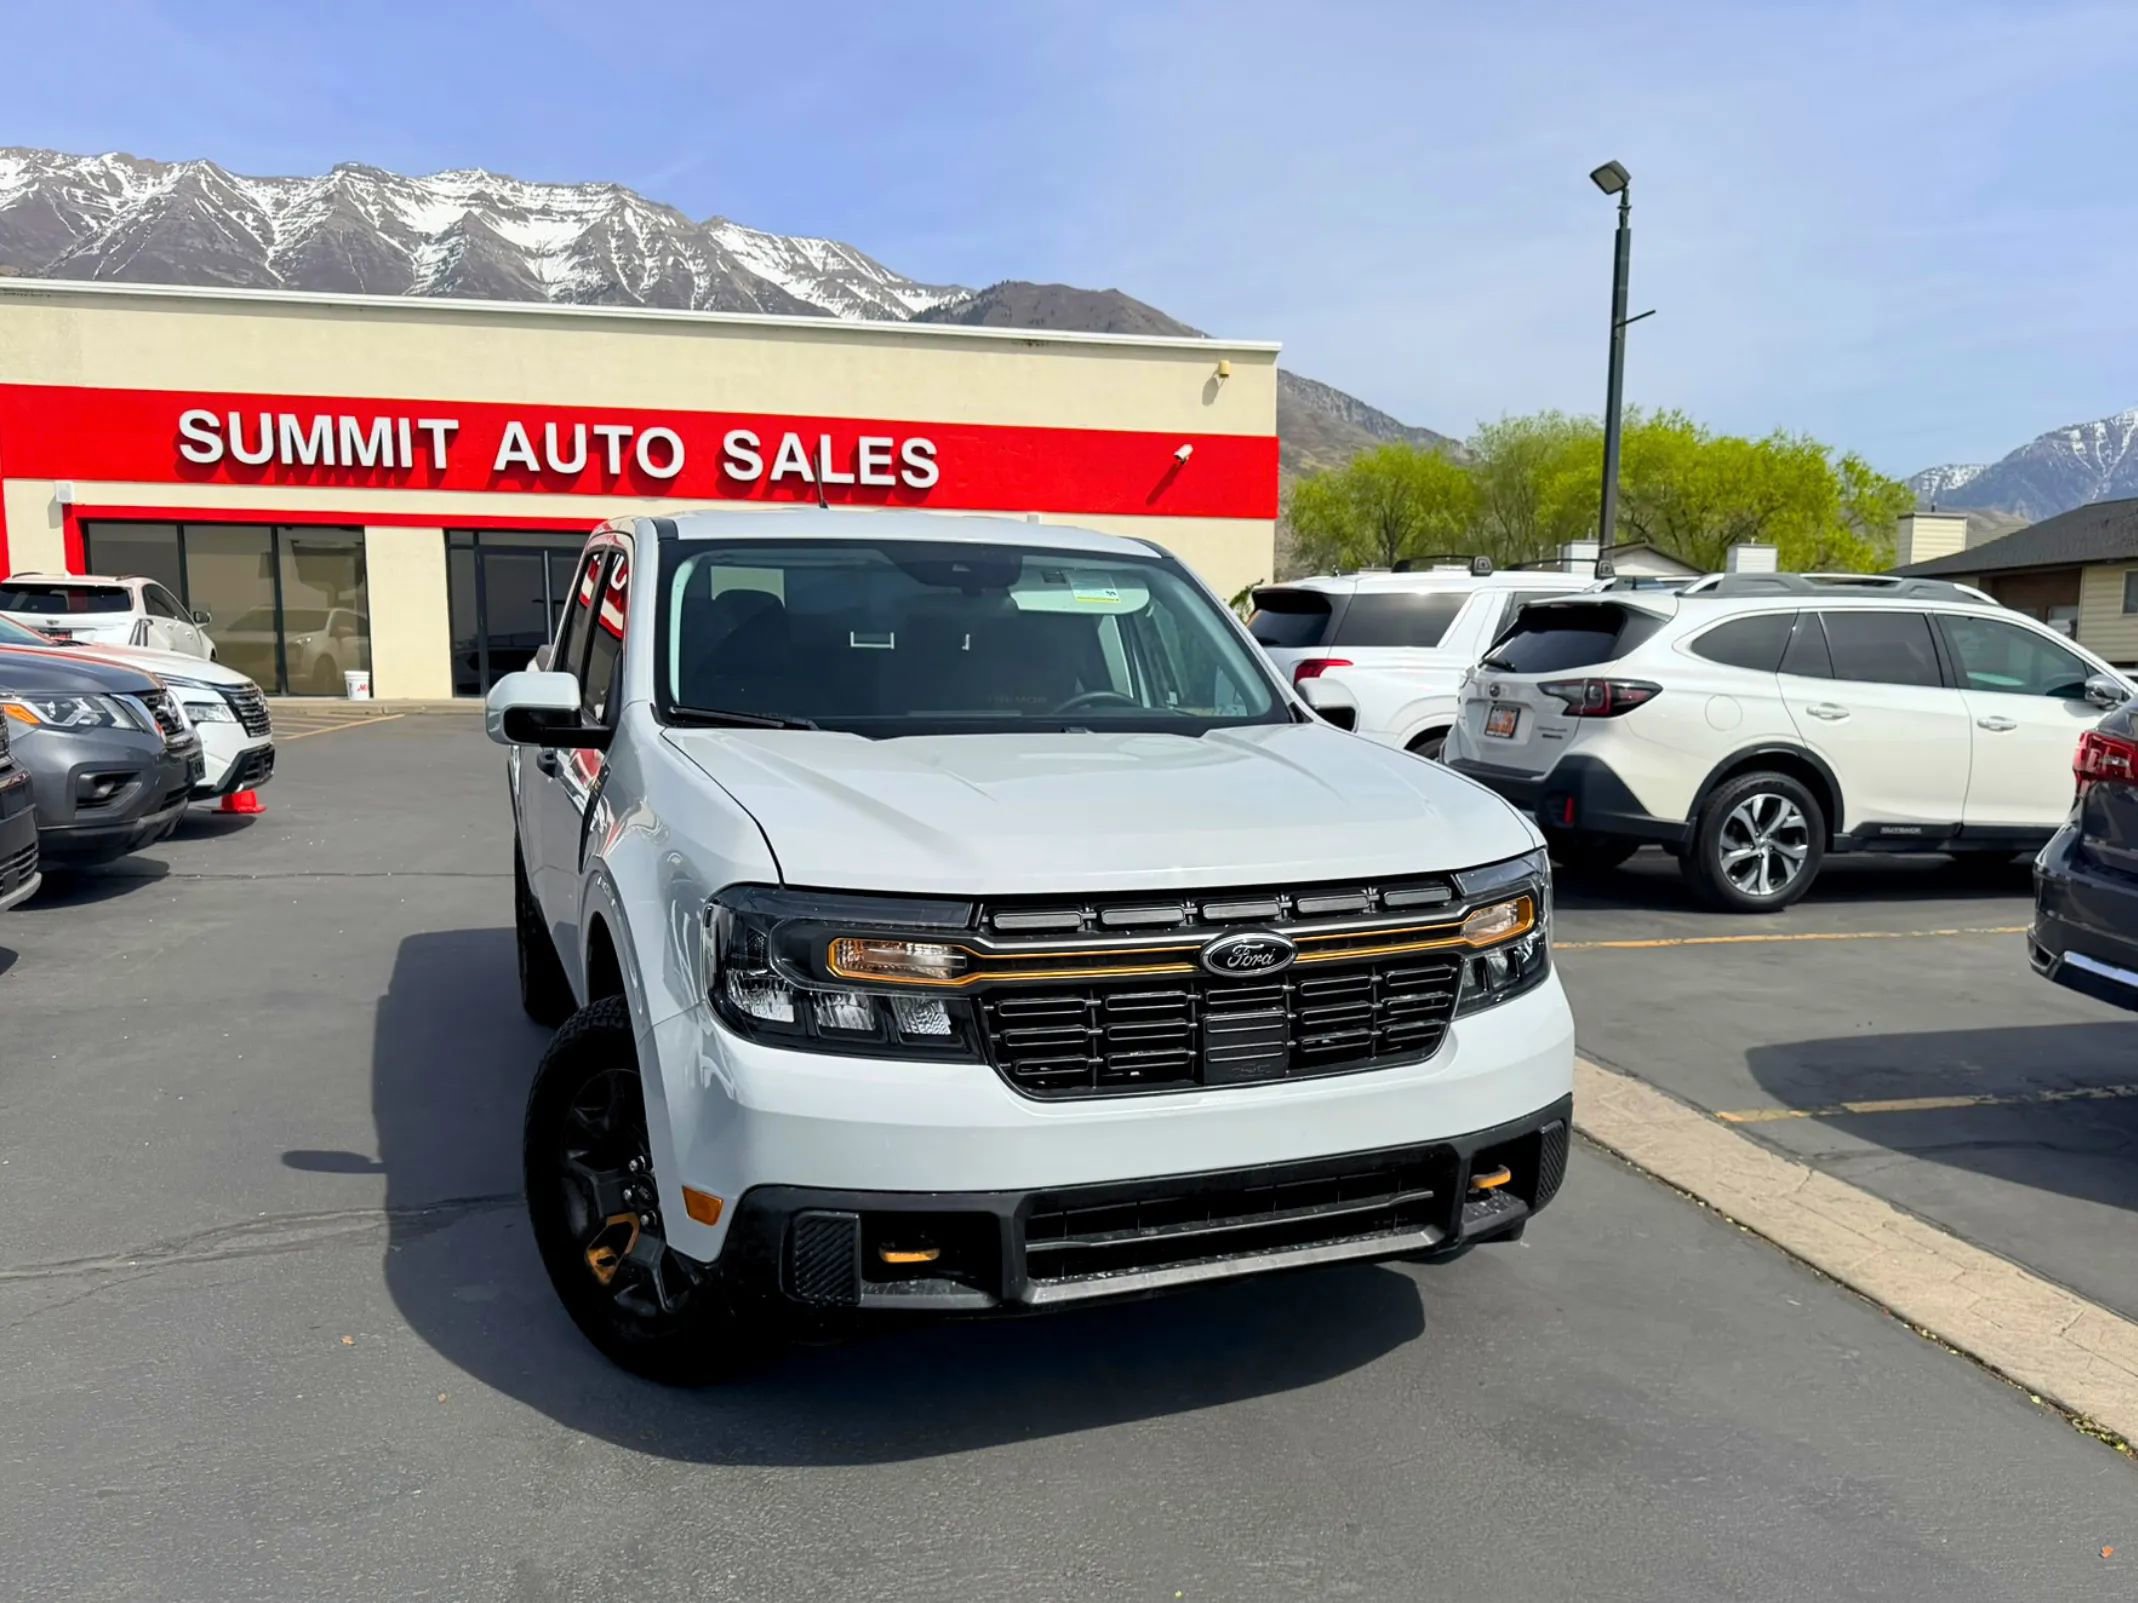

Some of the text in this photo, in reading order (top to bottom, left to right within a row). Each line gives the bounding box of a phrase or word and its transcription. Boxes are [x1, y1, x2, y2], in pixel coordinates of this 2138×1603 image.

[177, 408, 940, 489] SUMMIT AUTO SALES
[1226, 943, 1277, 969] Ford
